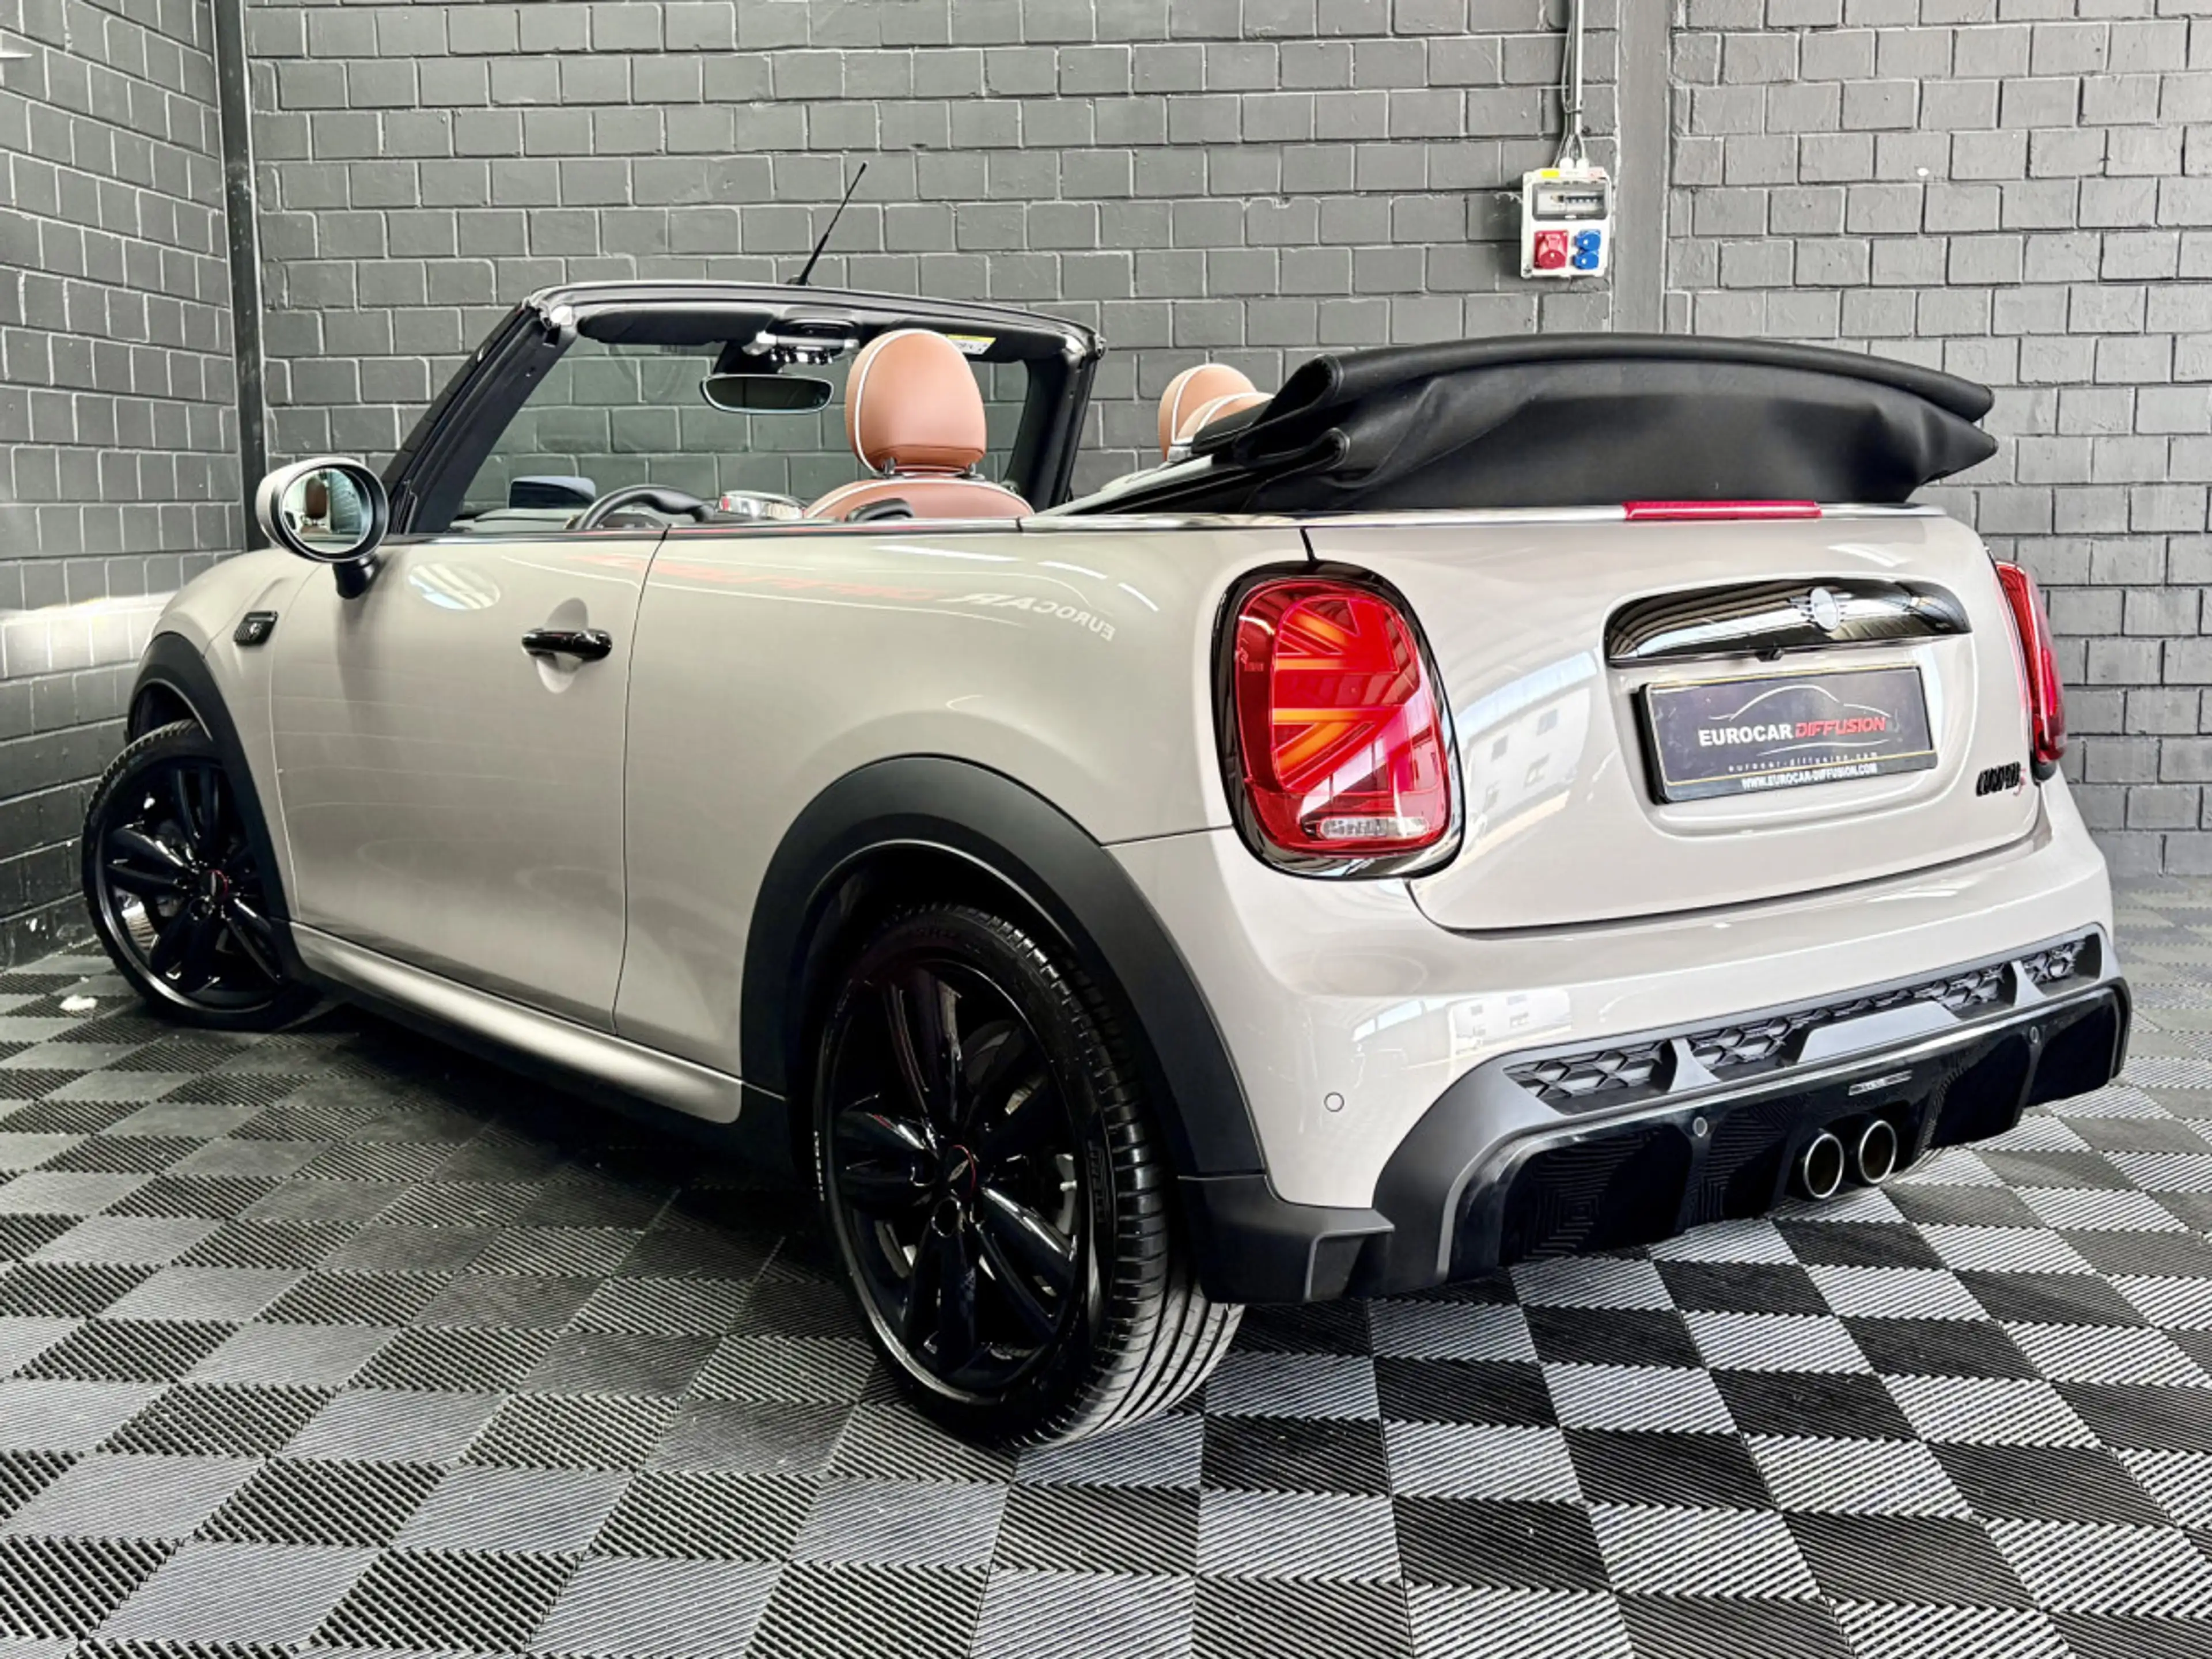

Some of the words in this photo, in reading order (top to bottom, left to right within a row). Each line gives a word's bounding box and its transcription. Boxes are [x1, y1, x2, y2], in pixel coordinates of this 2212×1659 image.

[1699, 724, 1793, 747] EUROCAR
[1794, 717, 1886, 738] DIFFUSION
[1741, 762, 1878, 790] WWW.EUROCAR-DIFFUSION.COM
